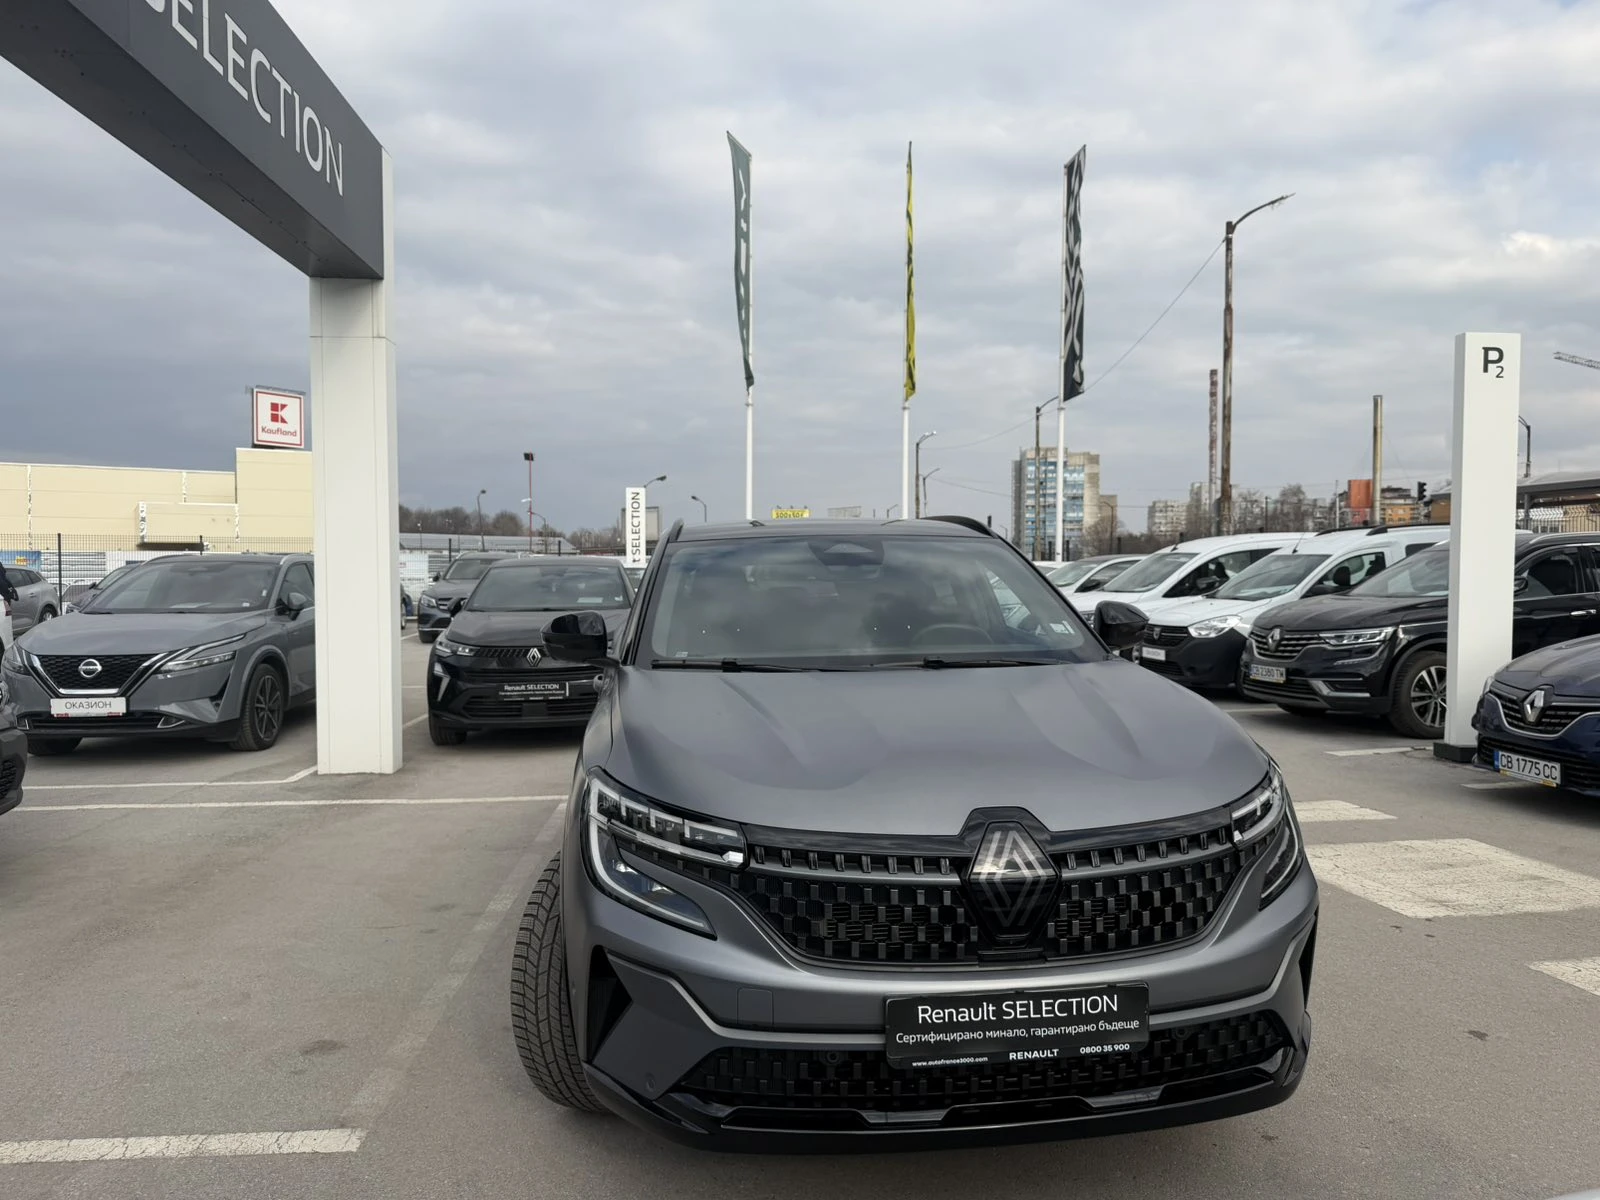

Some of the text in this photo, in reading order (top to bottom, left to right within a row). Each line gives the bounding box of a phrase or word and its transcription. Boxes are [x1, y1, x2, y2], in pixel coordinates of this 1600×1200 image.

[145, 0, 344, 197] ELECTION
[261, 426, 297, 437] Kaufland
[631, 491, 641, 556] SELECTION
[64, 701, 112, 710] ОКАЗИОН
[1516, 757, 1541, 776] 1775
[917, 994, 1118, 1024] Renault SELECTION
[896, 1020, 1140, 1045] Сертифицирано минало, гарантирано бъдеще
[1009, 1048, 1059, 1060] RENAULT
[1080, 1046, 1101, 1054] 0800
[1114, 1043, 1130, 1051] 900
[912, 1056, 988, 1067] www.autofrance3000.com
